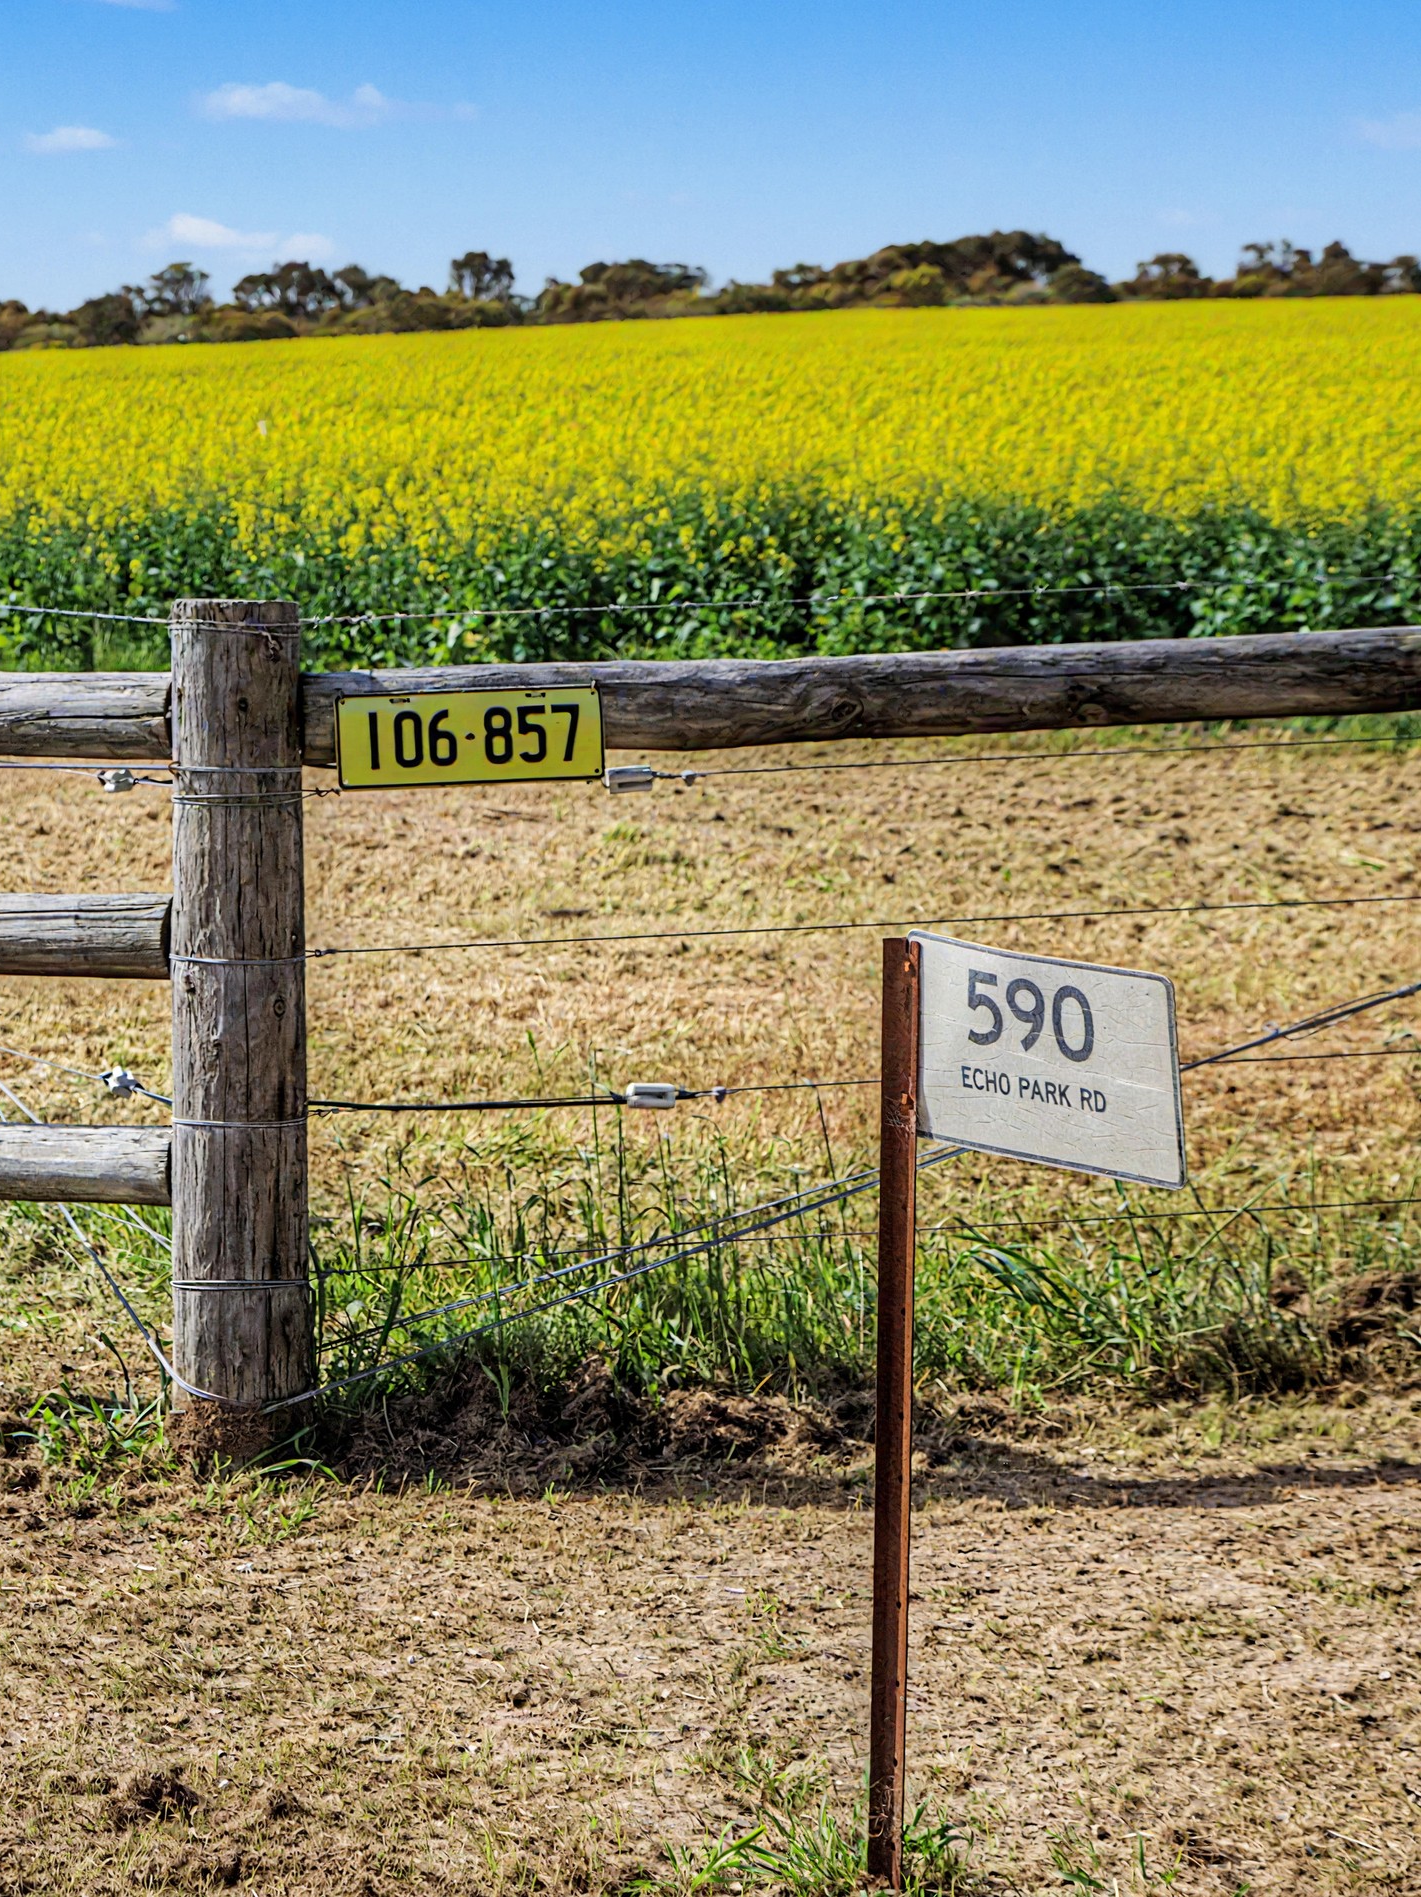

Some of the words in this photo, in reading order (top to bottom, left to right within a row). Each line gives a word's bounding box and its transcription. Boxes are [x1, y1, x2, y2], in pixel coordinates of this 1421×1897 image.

[967, 968, 1095, 1062] 590
[961, 1065, 1011, 1096] ECHO
[1018, 1077, 1072, 1107] PARK
[1079, 1087, 1107, 1113] RD
